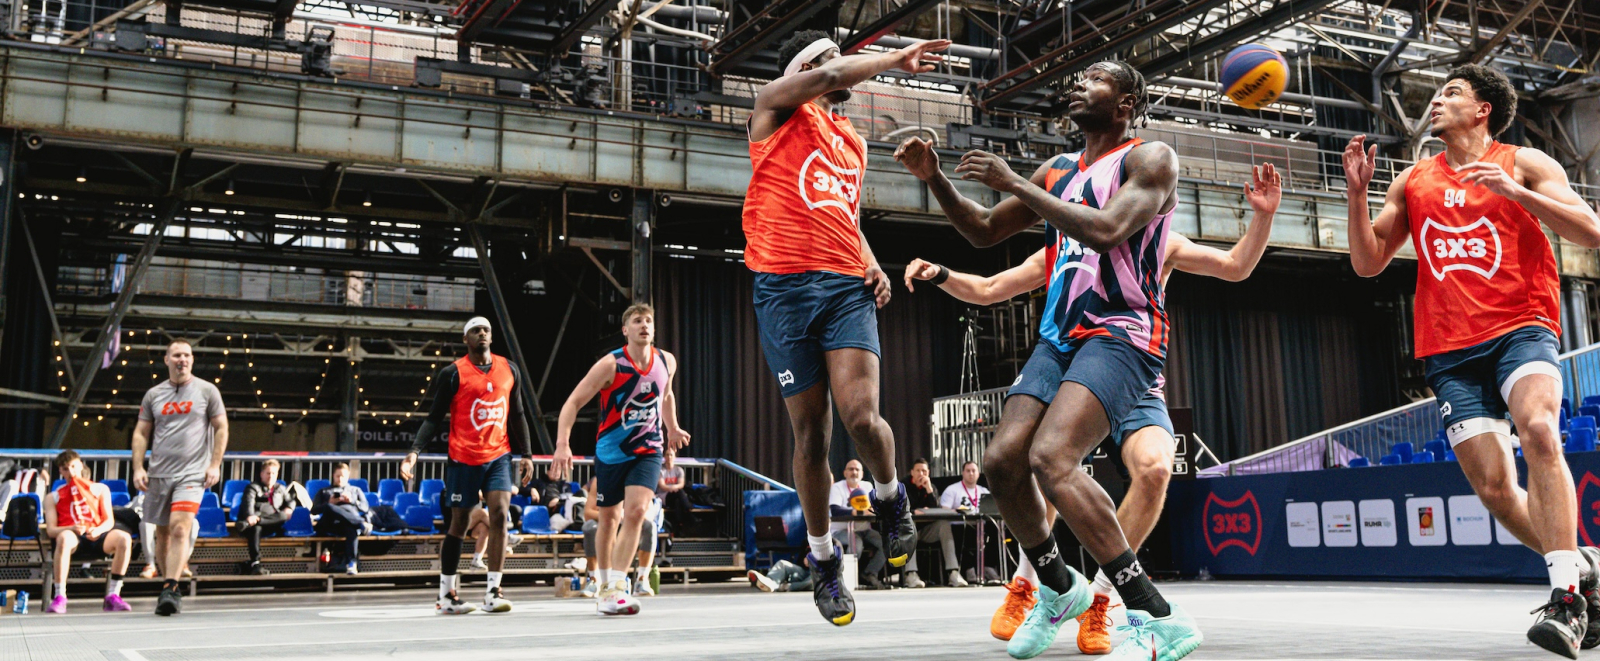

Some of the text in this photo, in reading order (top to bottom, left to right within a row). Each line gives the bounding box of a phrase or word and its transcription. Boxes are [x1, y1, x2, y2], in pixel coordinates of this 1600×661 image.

[1231, 72, 1271, 101] Wilson
[829, 132, 846, 152] 72
[812, 171, 857, 203] 3X3
[1443, 188, 1466, 208] 94
[1433, 238, 1487, 258] 3X3
[477, 407, 504, 420] 3X3
[628, 406, 657, 421] 3X3
[1212, 513, 1251, 534] 3X3
